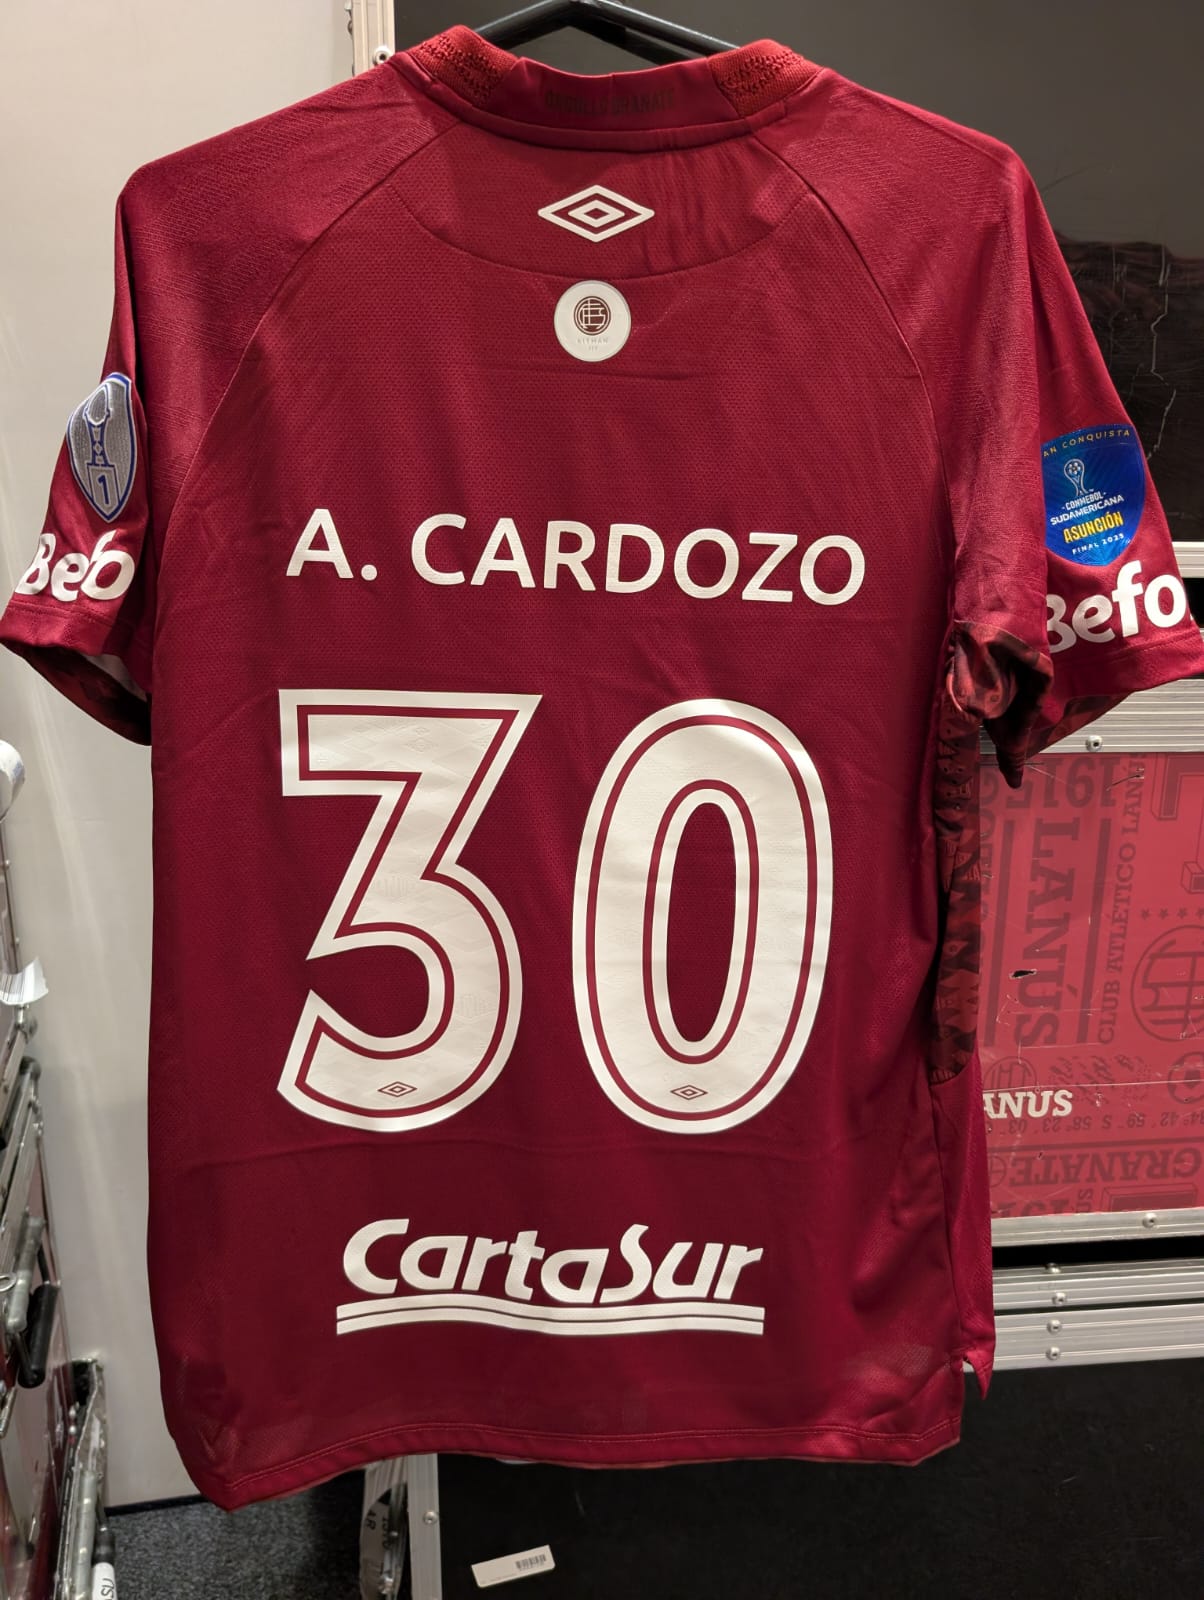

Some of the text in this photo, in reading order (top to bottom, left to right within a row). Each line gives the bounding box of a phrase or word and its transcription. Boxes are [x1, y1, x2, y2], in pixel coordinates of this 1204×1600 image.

[1061, 429, 1131, 449] CONQUISTA
[1050, 494, 1125, 526] SUDAMERICANA
[1063, 511, 1124, 544] ASUNCIÓN
[286, 508, 866, 606] A. CARDOZO
[1072, 542, 1100, 555] FINAL
[277, 689, 834, 1134] 30
[1014, 816, 1081, 1047] LANÚS
[1105, 842, 1137, 973] ATLÉTICO
[1098, 979, 1121, 1045] CLUB
[1008, 1146, 1202, 1188] GRANATE
[343, 1218, 764, 1303] CartaSur
